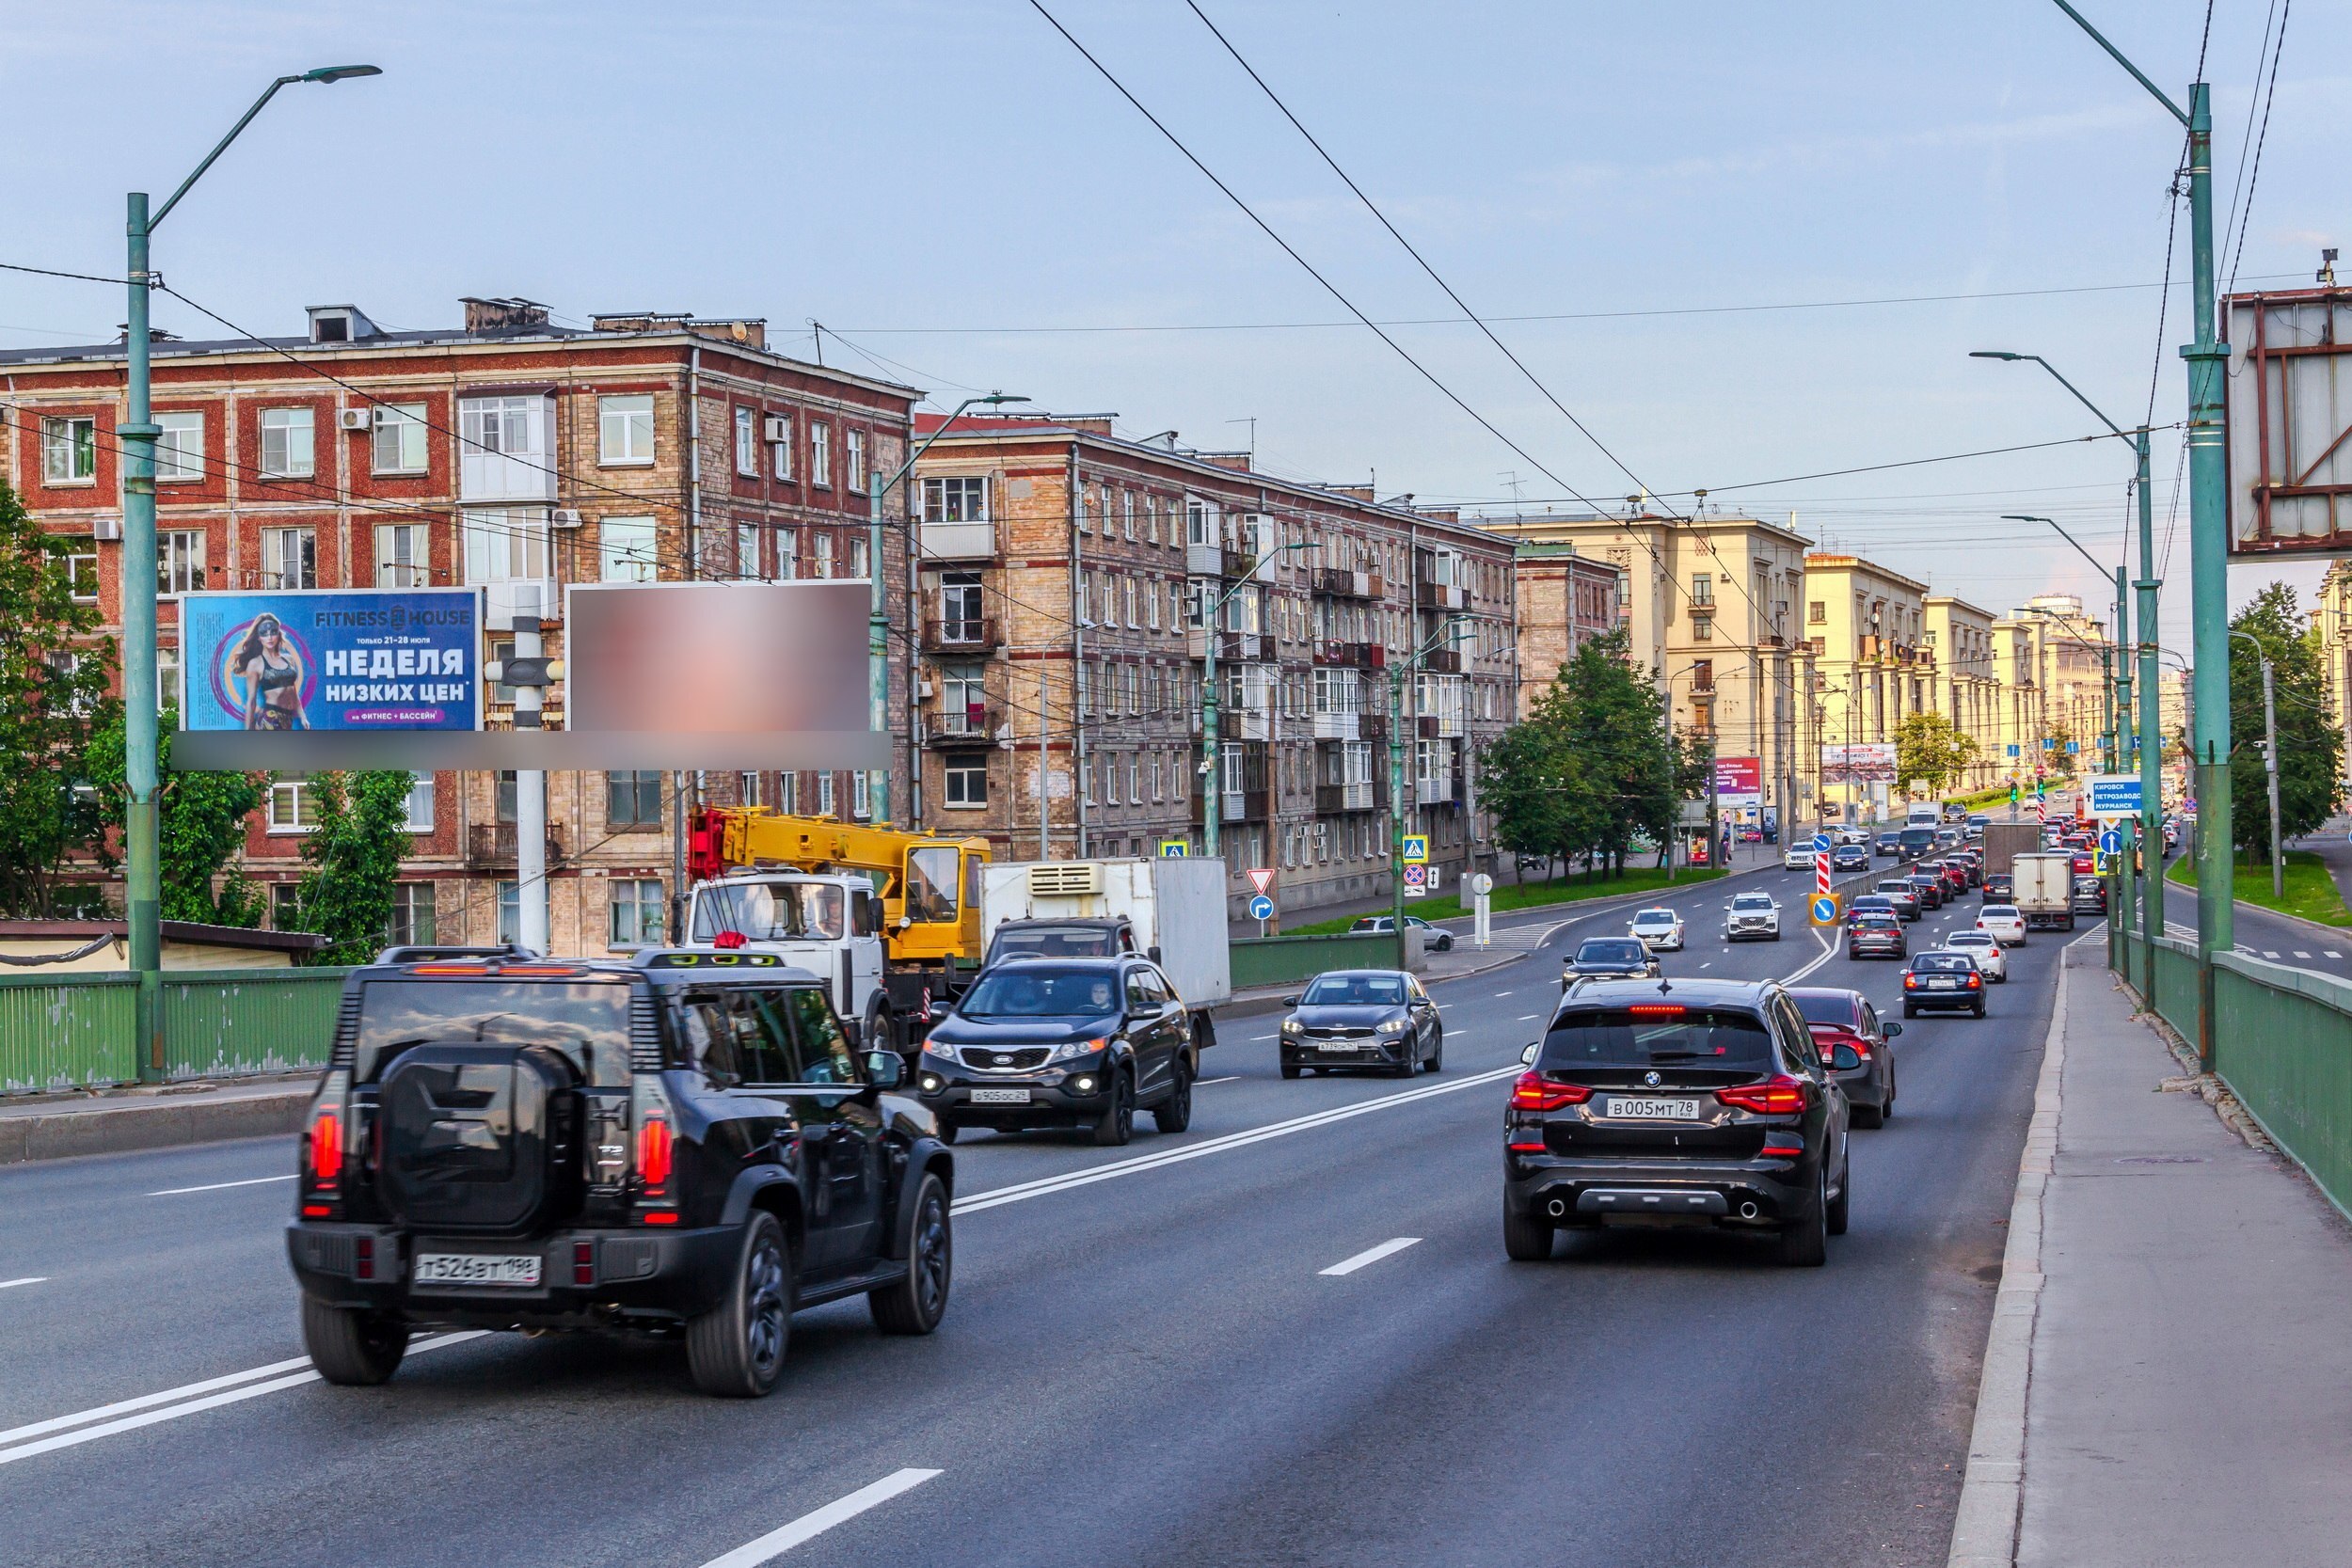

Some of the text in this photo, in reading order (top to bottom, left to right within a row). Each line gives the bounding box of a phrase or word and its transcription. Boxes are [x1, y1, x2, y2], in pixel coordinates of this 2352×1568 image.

[315, 610, 470, 627] FITNESS HOUSE
[326, 648, 464, 679] НЕДЕЛЯ
[326, 684, 415, 703] НИЗКИХ
[360, 711, 392, 721] ФИТНЕС
[1678, 1101, 1693, 1113] 78
